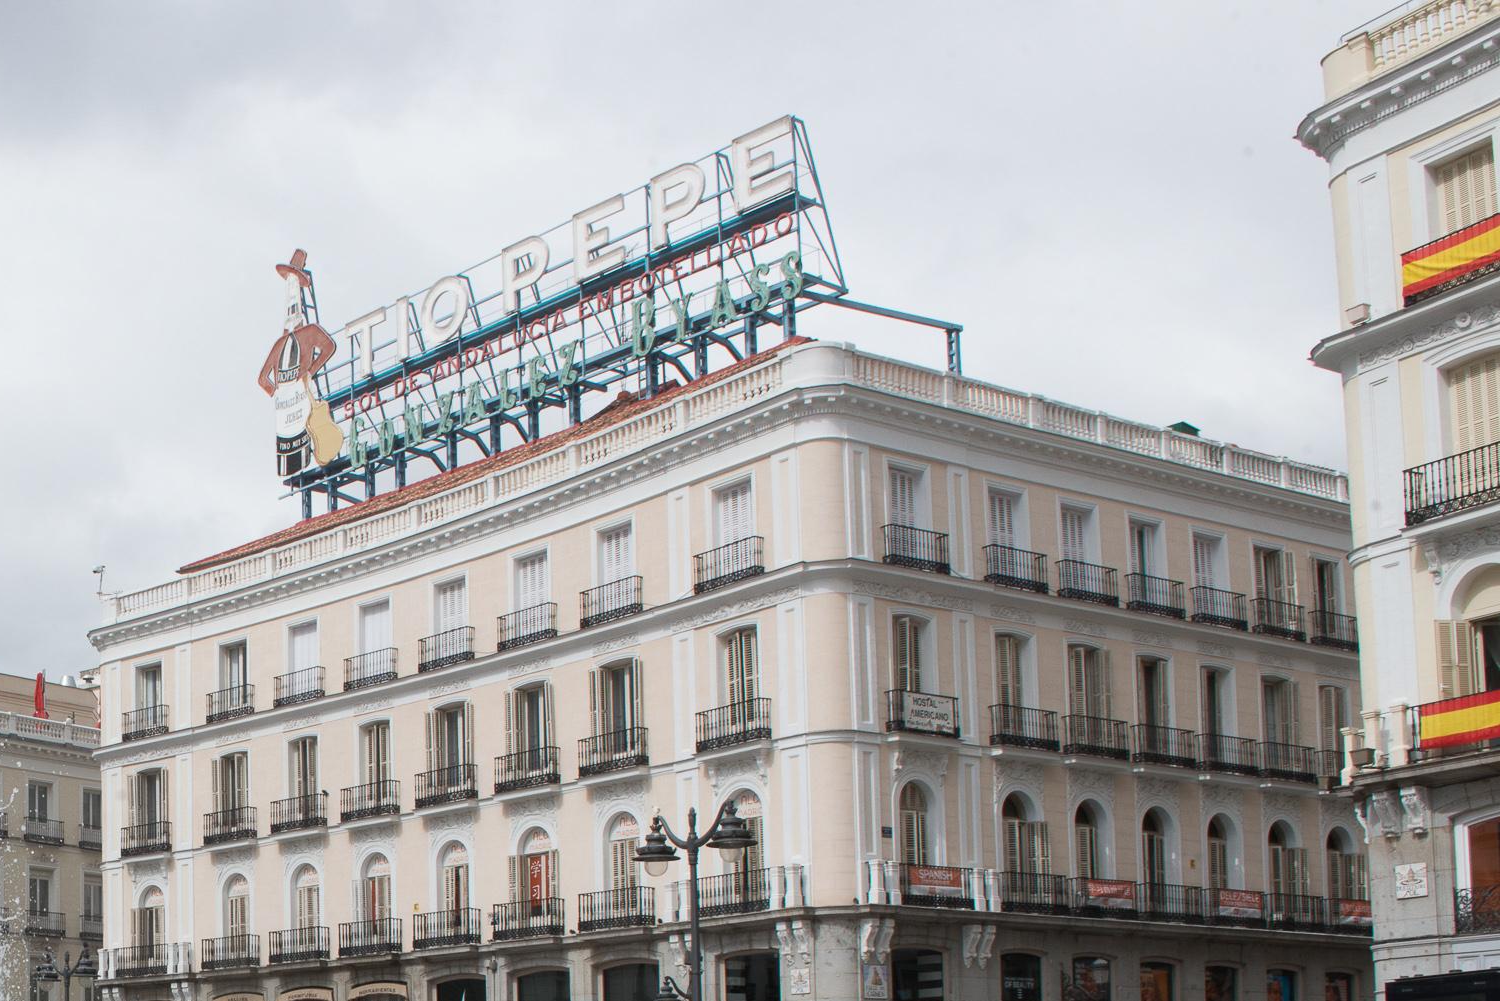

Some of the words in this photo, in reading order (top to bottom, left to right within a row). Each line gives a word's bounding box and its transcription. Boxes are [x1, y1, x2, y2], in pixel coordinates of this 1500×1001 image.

[345, 275, 469, 379] TIO
[502, 114, 794, 316] PEPE
[343, 391, 387, 419] SOL
[394, 368, 423, 397] DE
[432, 308, 567, 383] ANDALUCIA
[578, 212, 794, 319] EMBOTELLADO
[350, 340, 581, 468] GONZALEZ
[631, 250, 803, 360] BYASS
[910, 708, 949, 722] AMERICANO
[912, 696, 938, 709] HOSTAL
[918, 868, 953, 881] SPANISH
